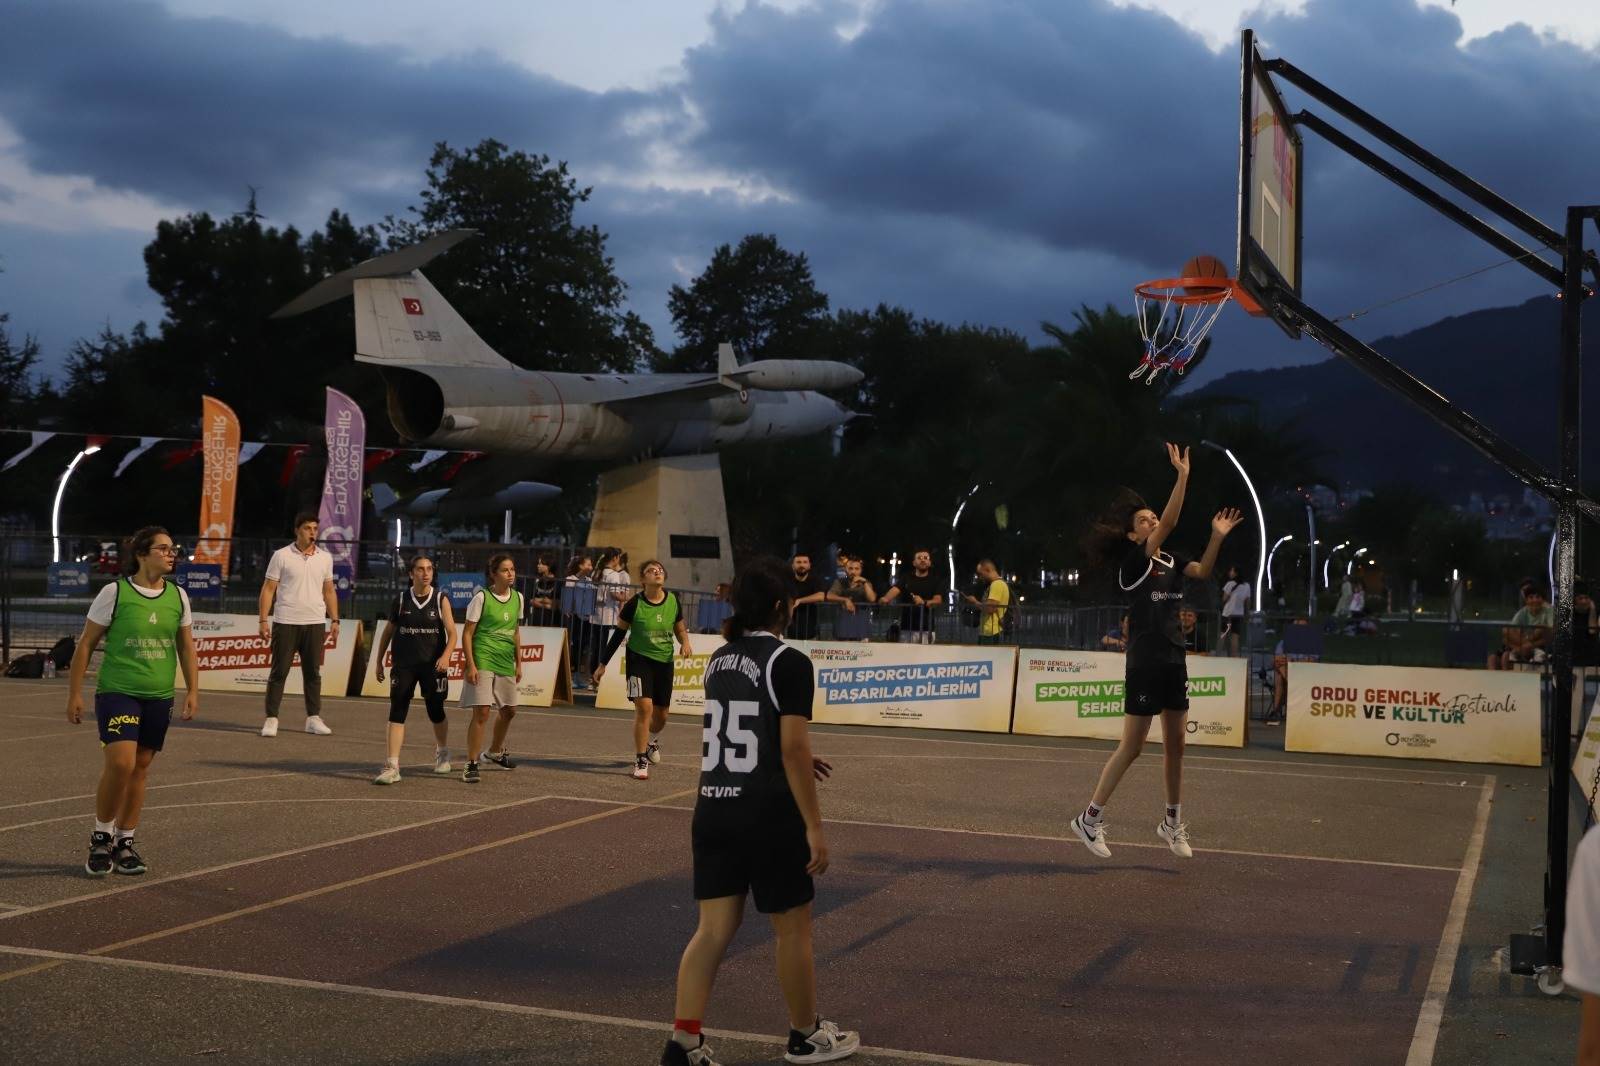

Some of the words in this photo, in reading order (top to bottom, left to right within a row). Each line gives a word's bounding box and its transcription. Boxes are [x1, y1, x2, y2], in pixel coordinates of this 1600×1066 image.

[149, 612, 158, 624] 4
[504, 612, 509, 621] 6
[656, 614, 662, 622] 5
[195, 637, 215, 651] ÜM
[738, 655, 762, 688] MUSIC
[821, 669, 853, 684] TÜM
[855, 664, 990, 683] SPORCULARIMIZA
[435, 678, 448, 693] 10
[828, 685, 913, 702] BAŞARILAR
[915, 680, 977, 697] DİLERİM
[1038, 684, 1101, 698] SPORUN
[1103, 684, 1123, 696] VE
[1311, 686, 1358, 702] ORDU
[1364, 688, 1441, 706] GENÇLİK
[1443, 693, 1517, 716] Festivali
[1310, 702, 1357, 718] SPOR
[1363, 704, 1386, 719] VE
[1392, 706, 1465, 724] KÜLTÜR
